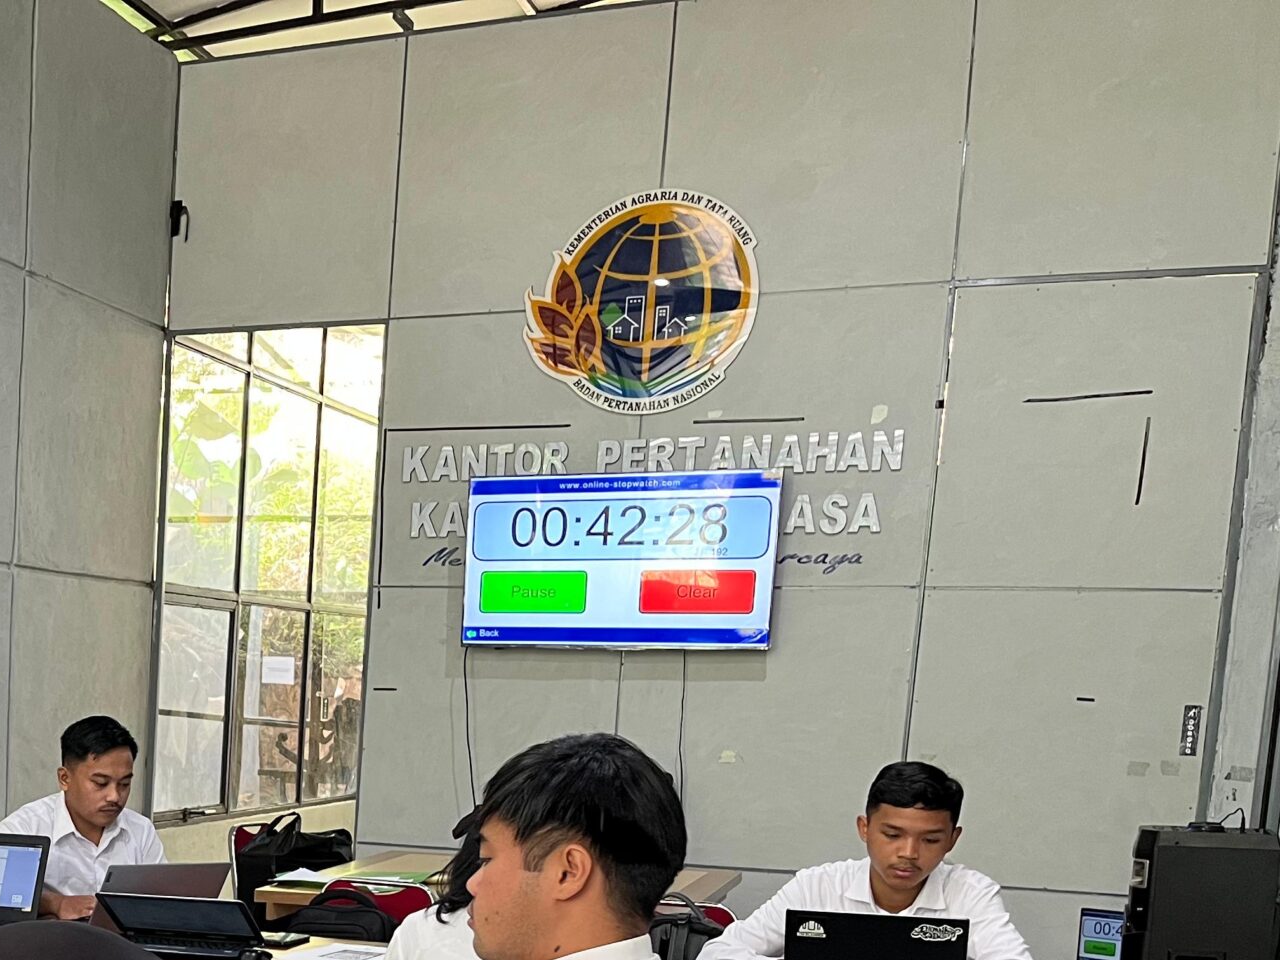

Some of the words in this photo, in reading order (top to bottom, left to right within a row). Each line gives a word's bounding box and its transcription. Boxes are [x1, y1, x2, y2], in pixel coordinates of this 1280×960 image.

[564, 200, 628, 256] KEMENTERIAN
[631, 190, 678, 207] AGRARIA
[681, 191, 701, 205] DAN
[705, 198, 729, 218] TATA
[727, 214, 753, 246] RUANG
[572, 378, 602, 406] BADAN
[602, 396, 670, 412] PERTANAHAN
[672, 371, 721, 403] NASIONAL
[401, 441, 570, 482] KANTOR
[596, 429, 904, 474] PERTANAHAN
[559, 478, 682, 490] www.online-stopwatch.com
[410, 500, 465, 538] KA
[784, 493, 882, 535] ASA
[510, 502, 729, 548] 00:42:28
[422, 546, 464, 567] Me
[777, 552, 863, 575] rcaya
[511, 585, 557, 598] Pause
[677, 585, 719, 598] Clear
[479, 628, 500, 638] Back
[1094, 921, 1124, 937] 00:4
